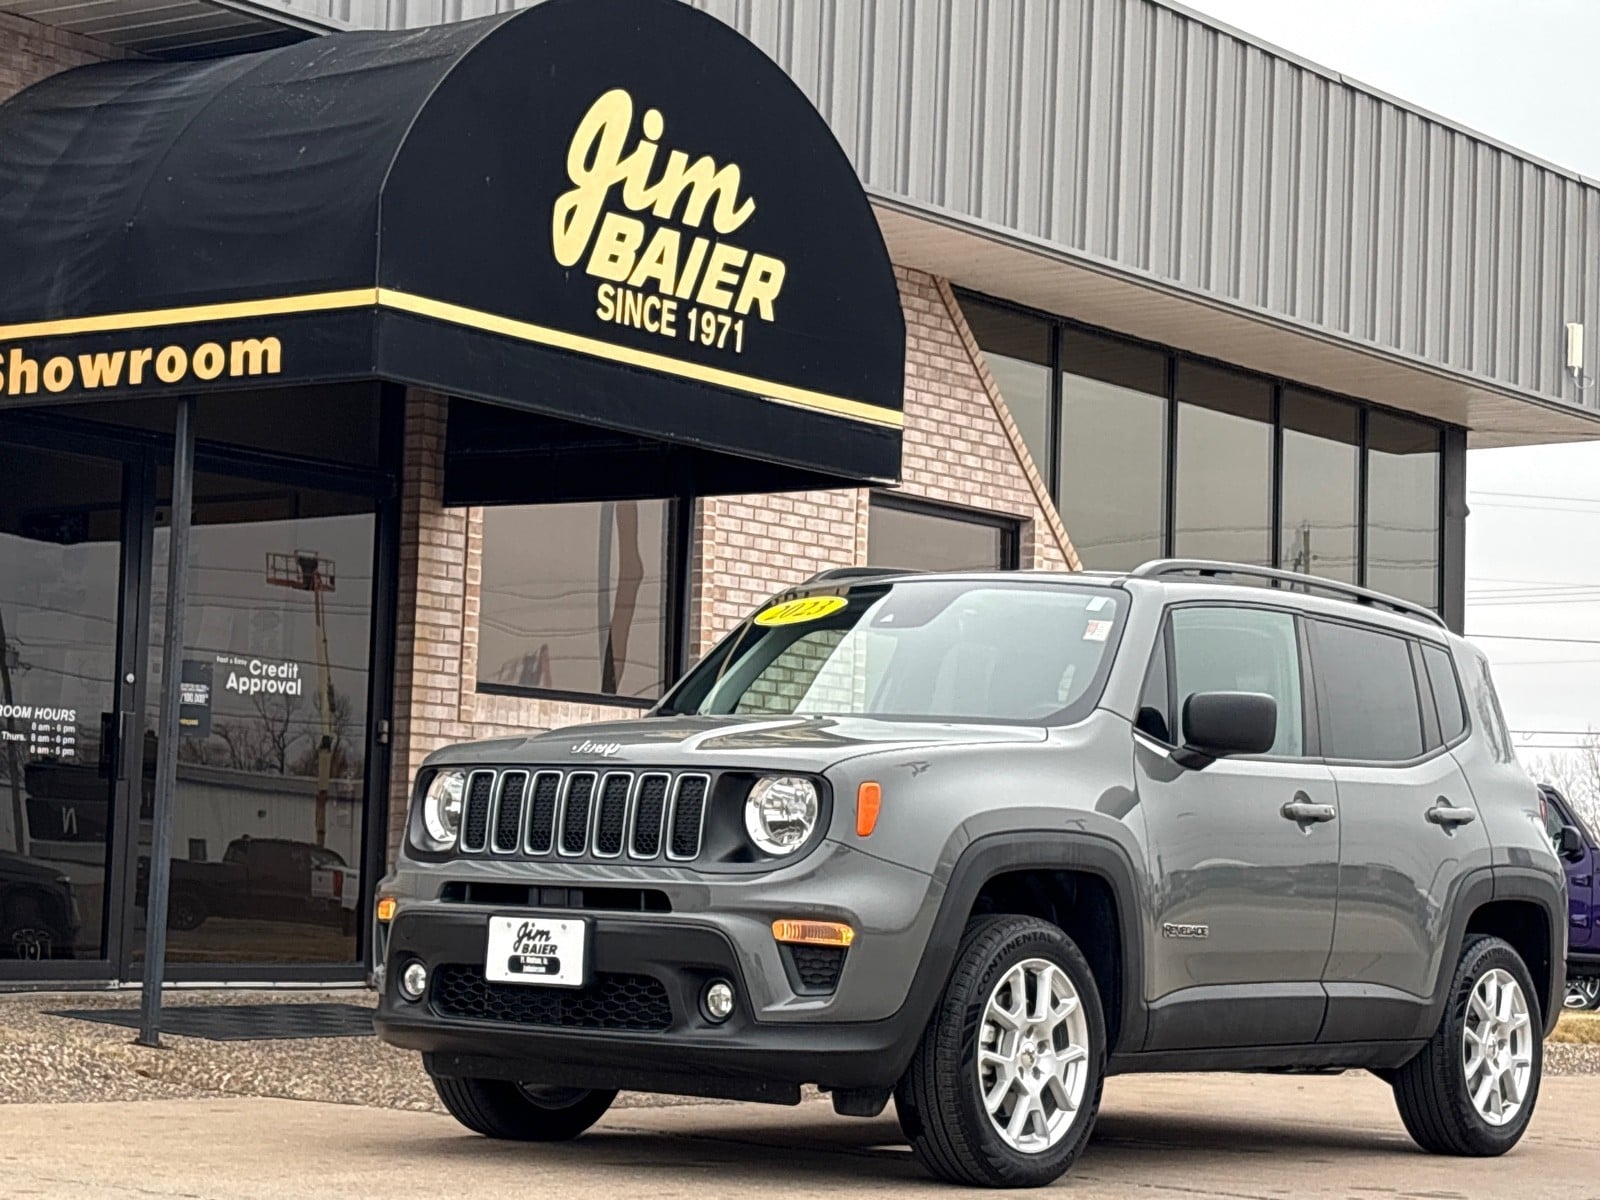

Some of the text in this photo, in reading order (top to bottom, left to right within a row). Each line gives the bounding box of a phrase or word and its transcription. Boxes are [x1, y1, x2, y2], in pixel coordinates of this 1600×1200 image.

[552, 88, 756, 267] Jim
[585, 211, 786, 322] BAIER
[596, 283, 744, 353] SINCE 1971
[0, 336, 281, 396] howroom
[225, 672, 302, 696] Approval
[249, 660, 299, 679] Credit
[34, 707, 77, 722] HOURS
[512, 921, 552, 953] Jim
[521, 943, 558, 955] BAIER
[977, 931, 1055, 996] CONTINENTAL
